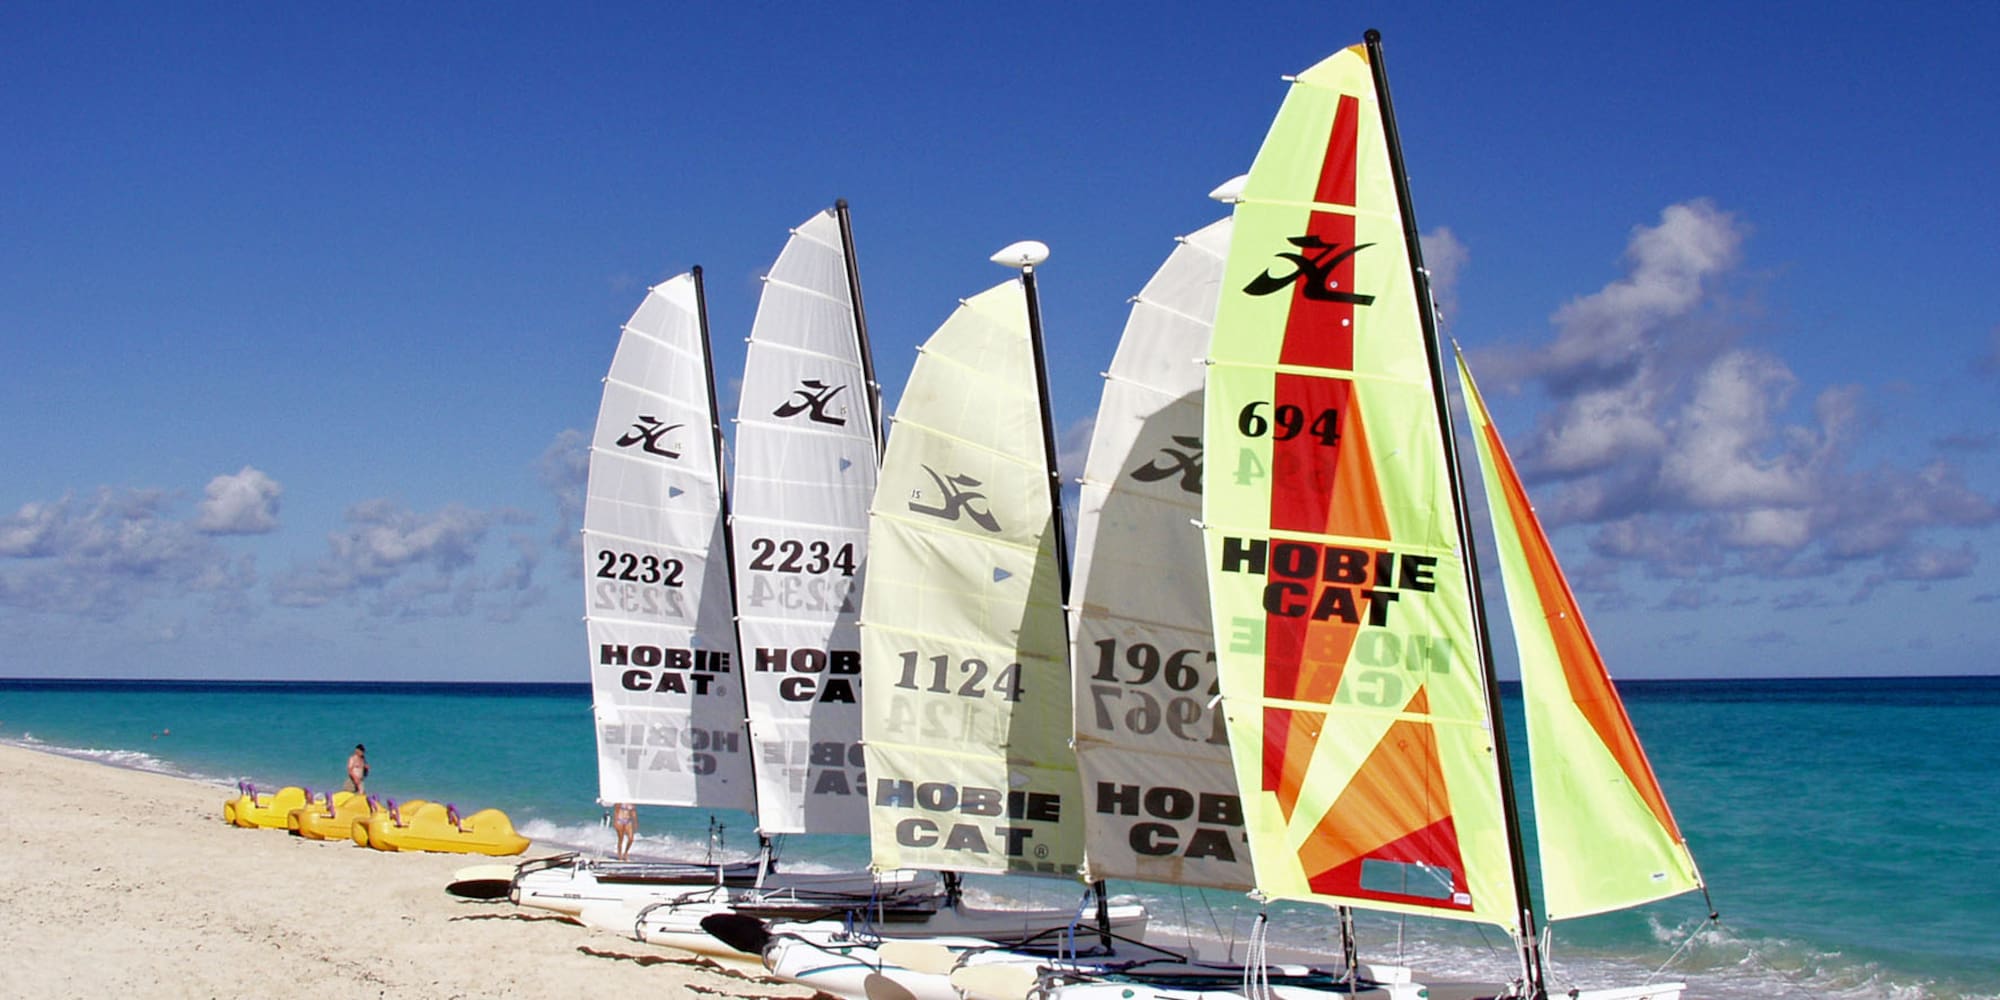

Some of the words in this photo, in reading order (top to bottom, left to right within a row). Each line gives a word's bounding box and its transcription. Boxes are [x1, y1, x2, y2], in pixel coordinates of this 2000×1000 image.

[1238, 401, 1341, 446] 694
[597, 550, 684, 587] 2232
[749, 538, 856, 576] 2234
[1221, 537, 1438, 592] HOBIE
[1263, 582, 1399, 627] CAT
[600, 644, 730, 673] HOBIE
[894, 651, 1025, 701] 1124
[621, 669, 715, 695] CAT
[779, 677, 861, 704] CA
[876, 778, 1060, 823] HOBIE
[896, 818, 1033, 857] CAT
[1128, 822, 1248, 862] CA
